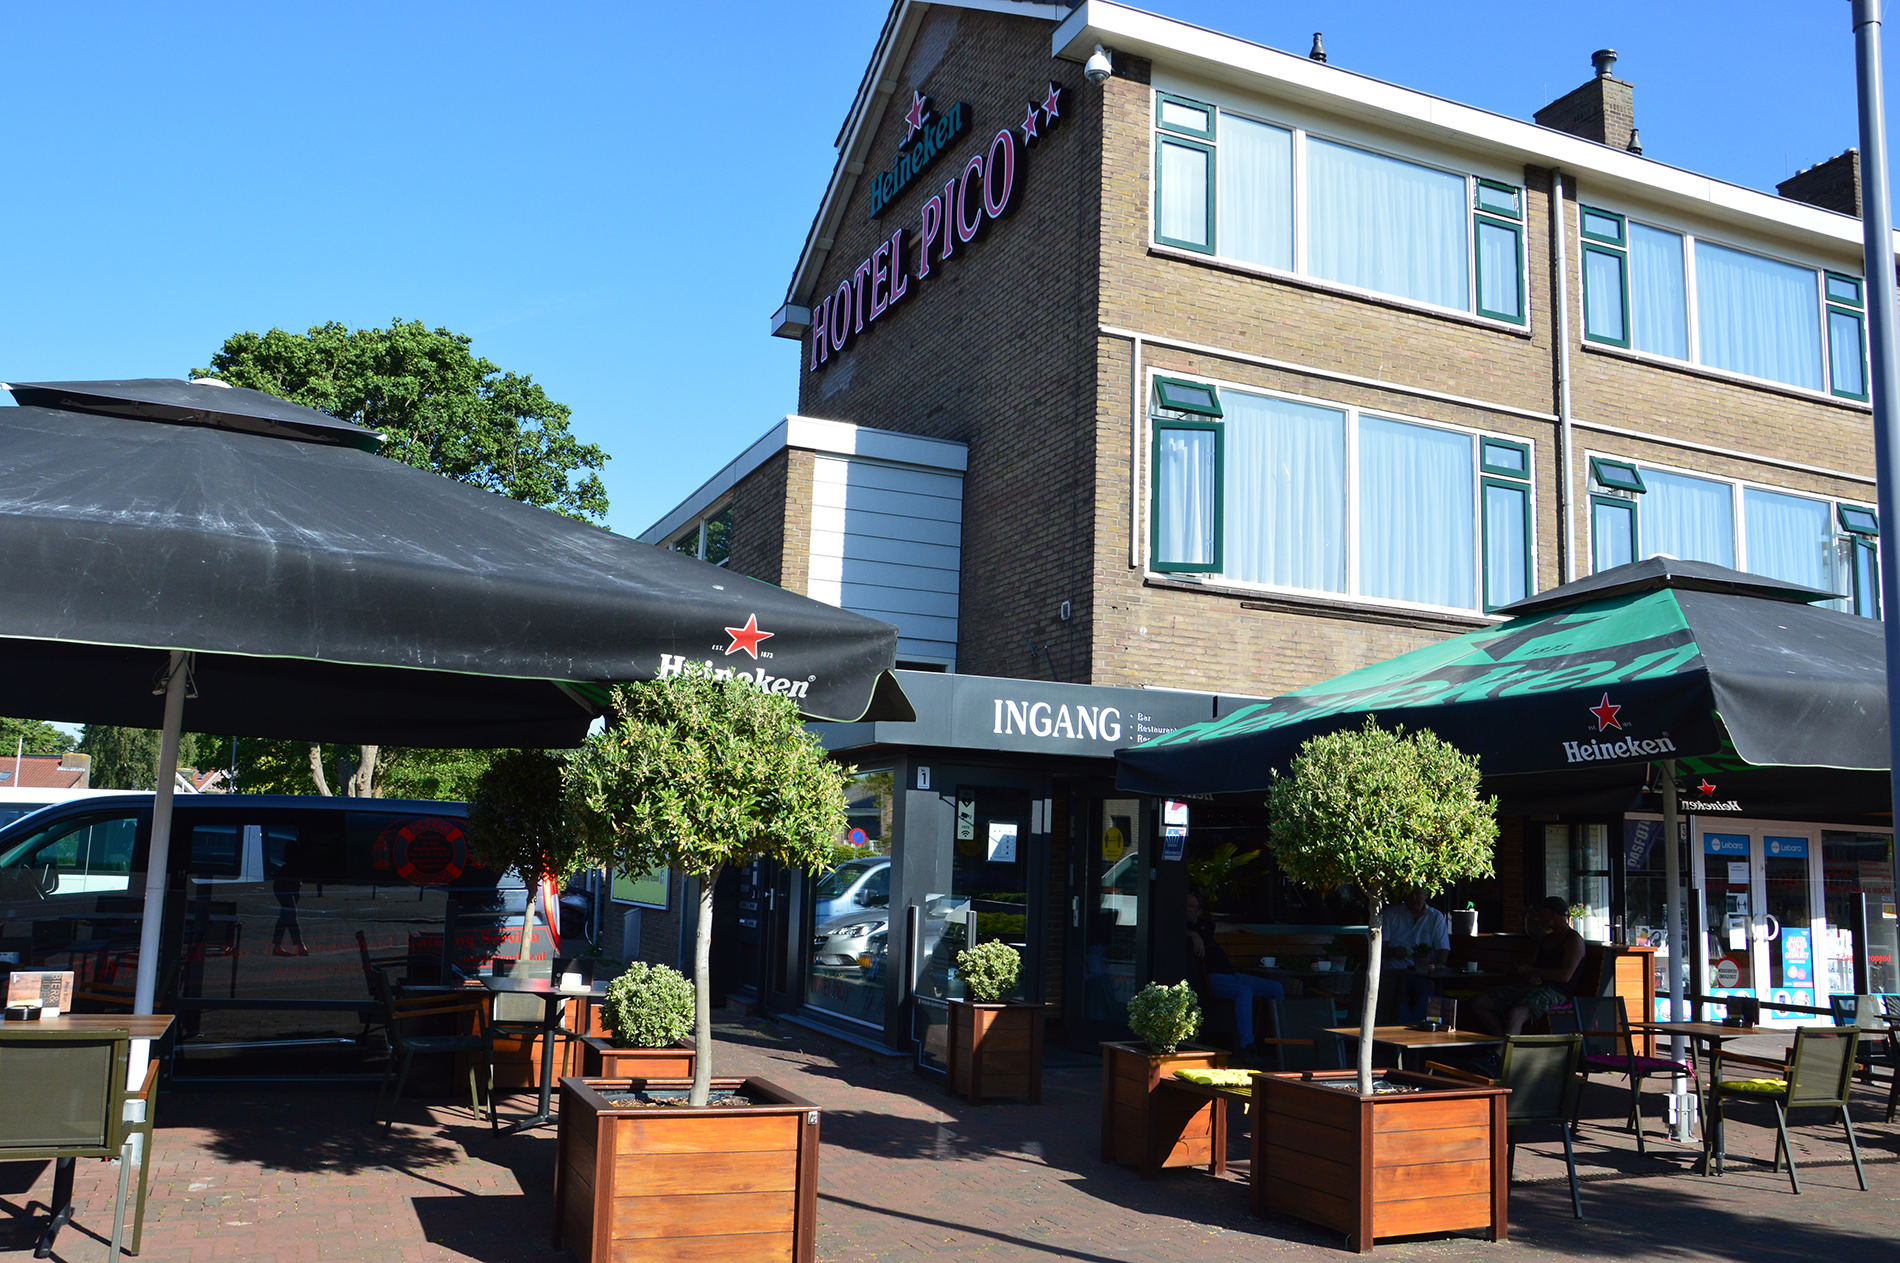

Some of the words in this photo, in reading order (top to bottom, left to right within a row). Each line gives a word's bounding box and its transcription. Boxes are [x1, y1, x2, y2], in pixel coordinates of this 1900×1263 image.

[869, 101, 963, 219] Heineken
[810, 228, 908, 371] HOTEL
[919, 128, 1015, 280] PICO
[711, 644, 724, 652] EST.
[760, 651, 774, 659] 1873
[657, 653, 810, 698] Hinken
[993, 699, 1122, 742] INGANG
[1137, 712, 1152, 722] Bar
[1562, 736, 1677, 763] Heineken
[921, 773, 926, 785] 1
[1722, 841, 1743, 849] Lebara
[1781, 844, 1802, 852] Lebara
[410, 872, 450, 883] HOLLAND
[1872, 886, 1892, 894] wacht
[405, 934, 476, 948] Cateng
[480, 931, 539, 945] Servie
[464, 951, 546, 964] www.pico-r.nl
[1868, 954, 1891, 964] eopend
